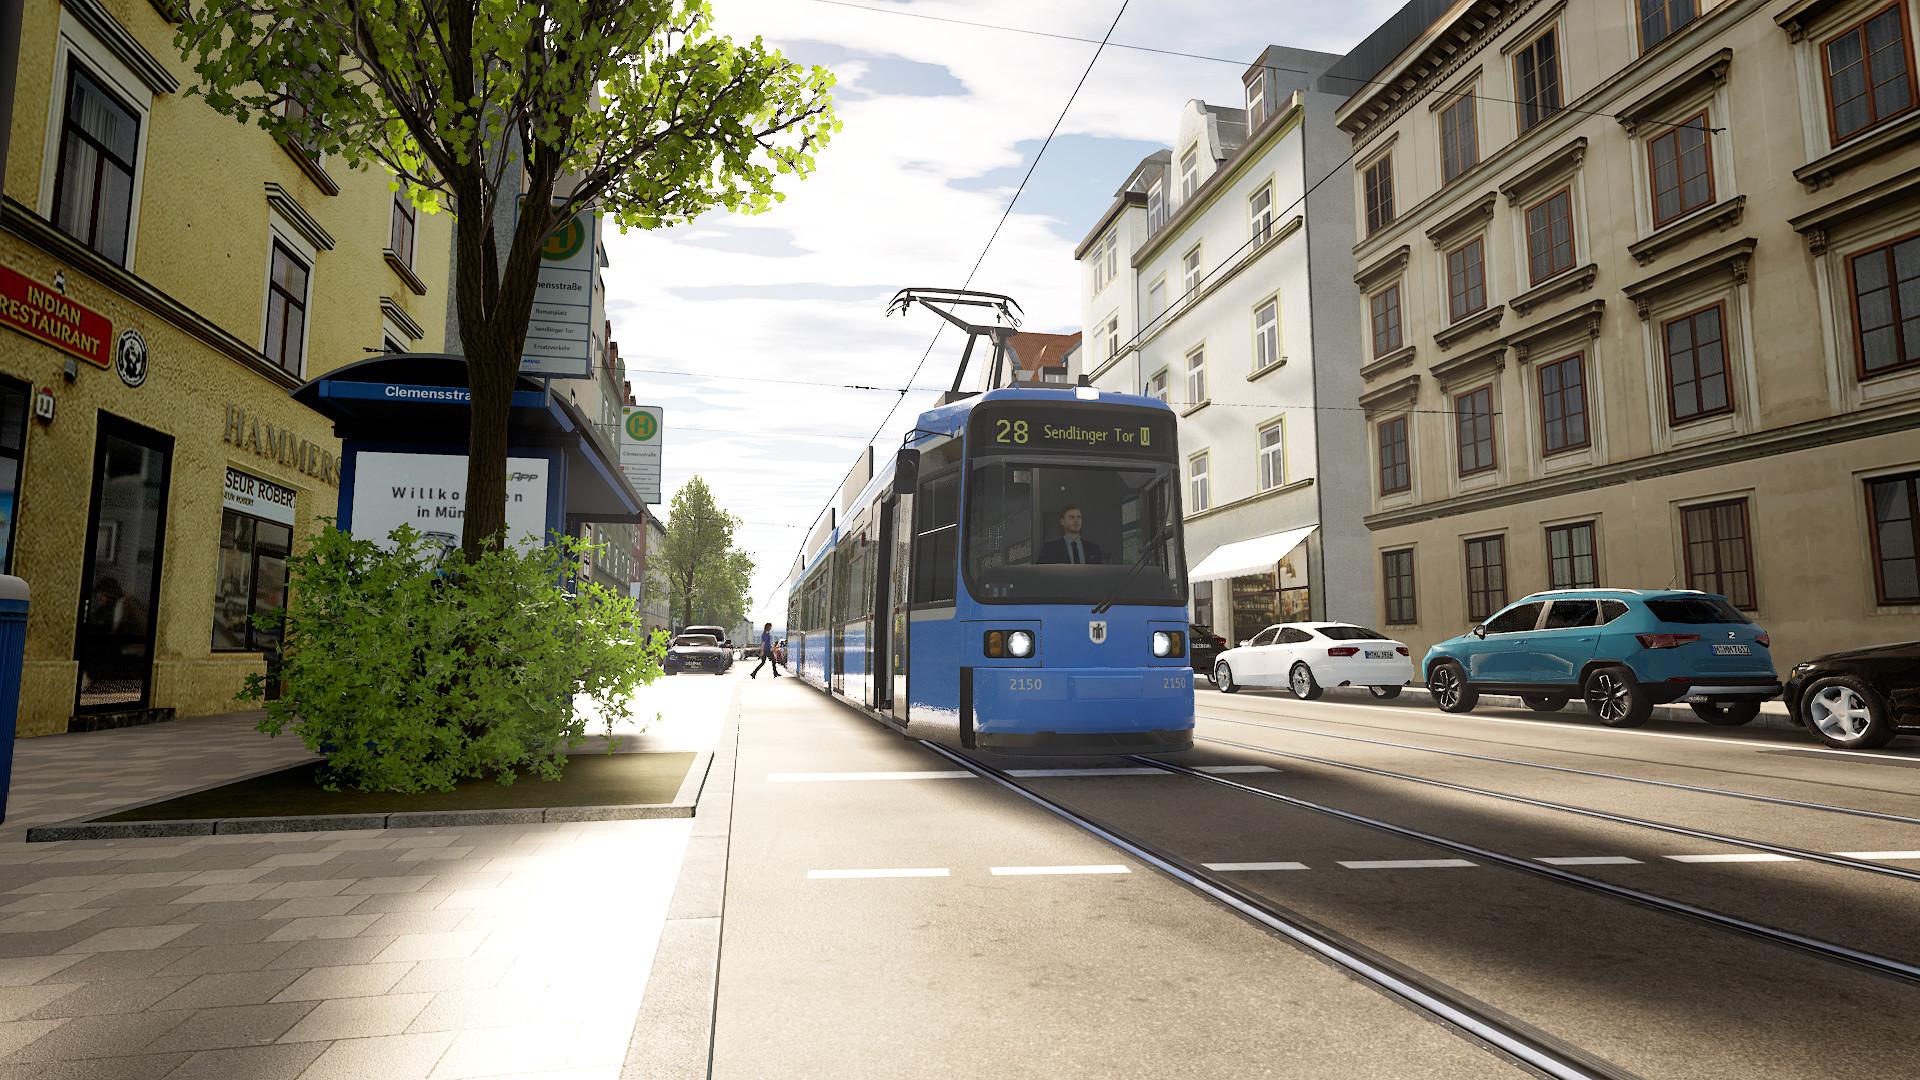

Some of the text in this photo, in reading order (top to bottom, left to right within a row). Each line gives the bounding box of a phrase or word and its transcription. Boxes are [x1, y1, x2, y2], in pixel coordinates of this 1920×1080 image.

[27, 286, 81, 327] INDIAN
[0, 294, 100, 356] RESTAURANT
[385, 386, 471, 400] Clemensstra
[996, 419, 1029, 444] 28
[1044, 424, 1108, 445] Sendlinger
[1114, 427, 1134, 442] Tor
[417, 506, 430, 518] in
[1009, 678, 1042, 690] 2150
[1163, 677, 1186, 689] 2150
